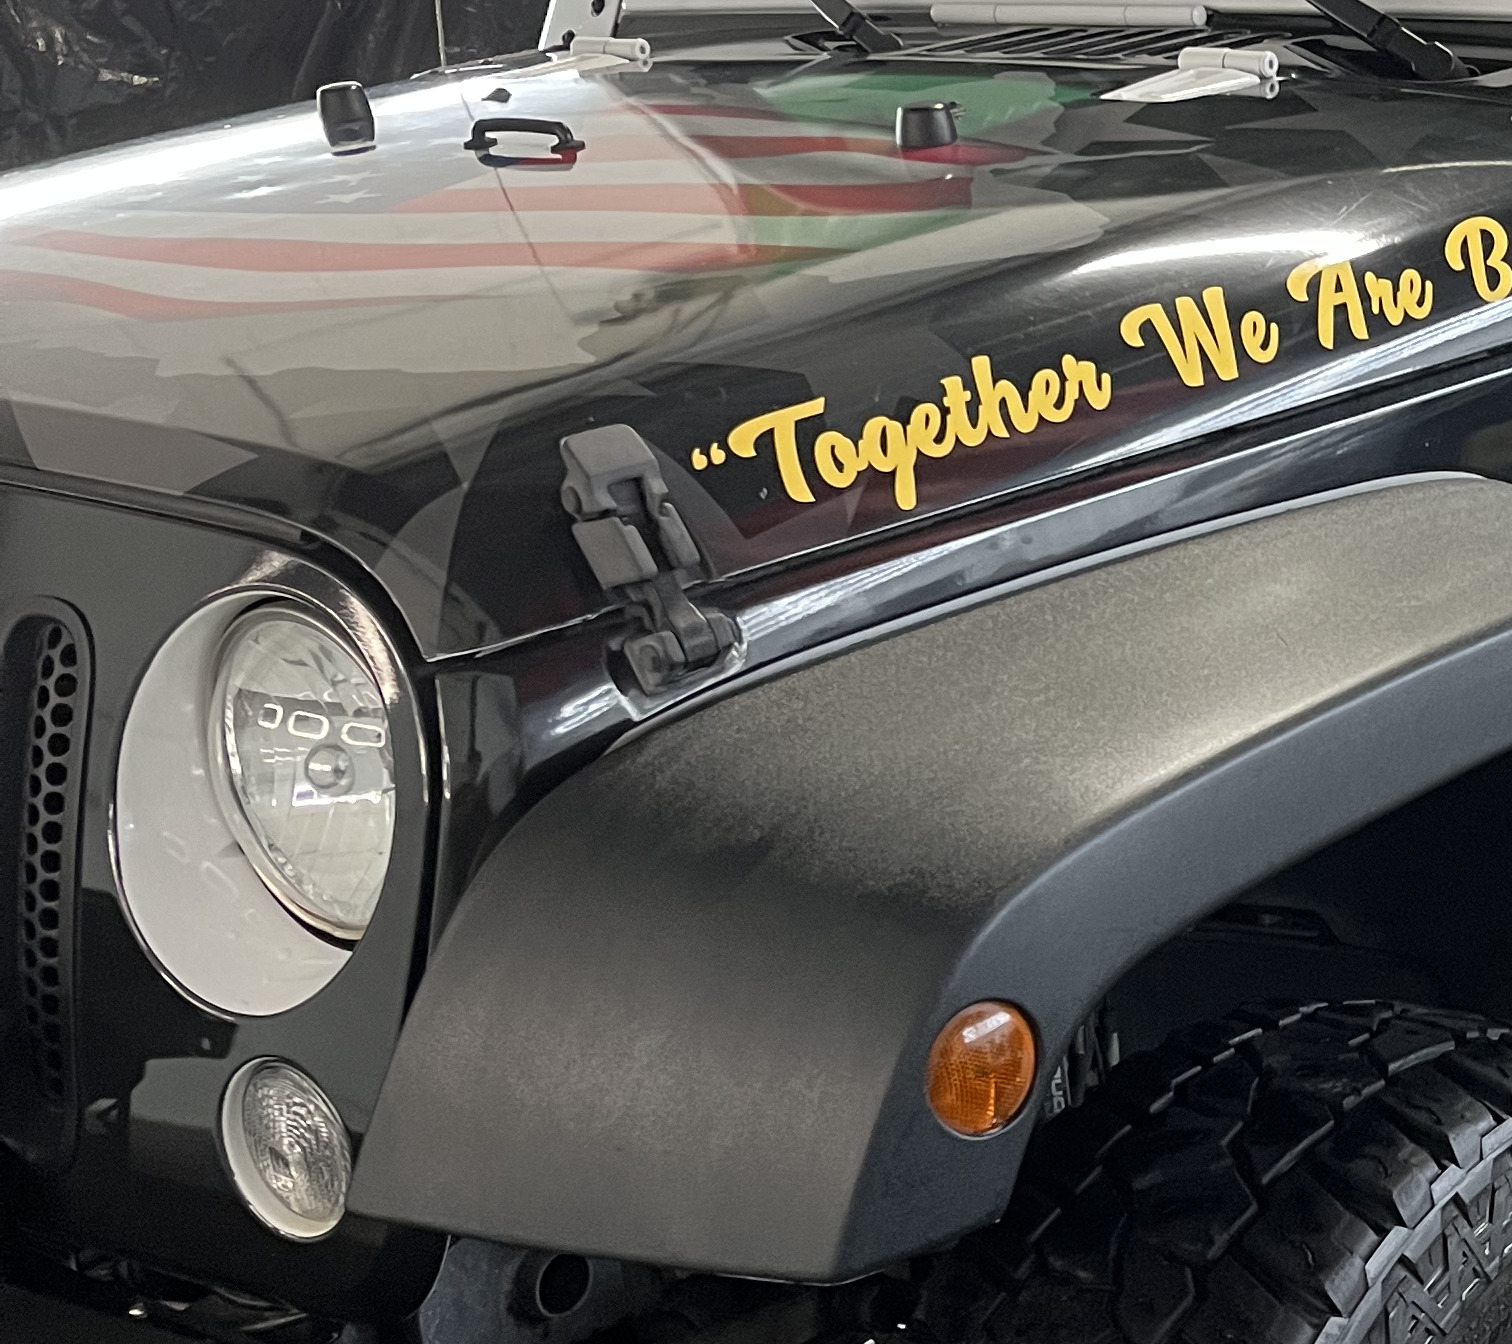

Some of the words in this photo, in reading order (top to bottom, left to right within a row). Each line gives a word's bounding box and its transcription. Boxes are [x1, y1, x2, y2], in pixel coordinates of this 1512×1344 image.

[692, 354, 1111, 511] “Together
[1120, 286, 1279, 388] We
[1286, 256, 1434, 350] Are
